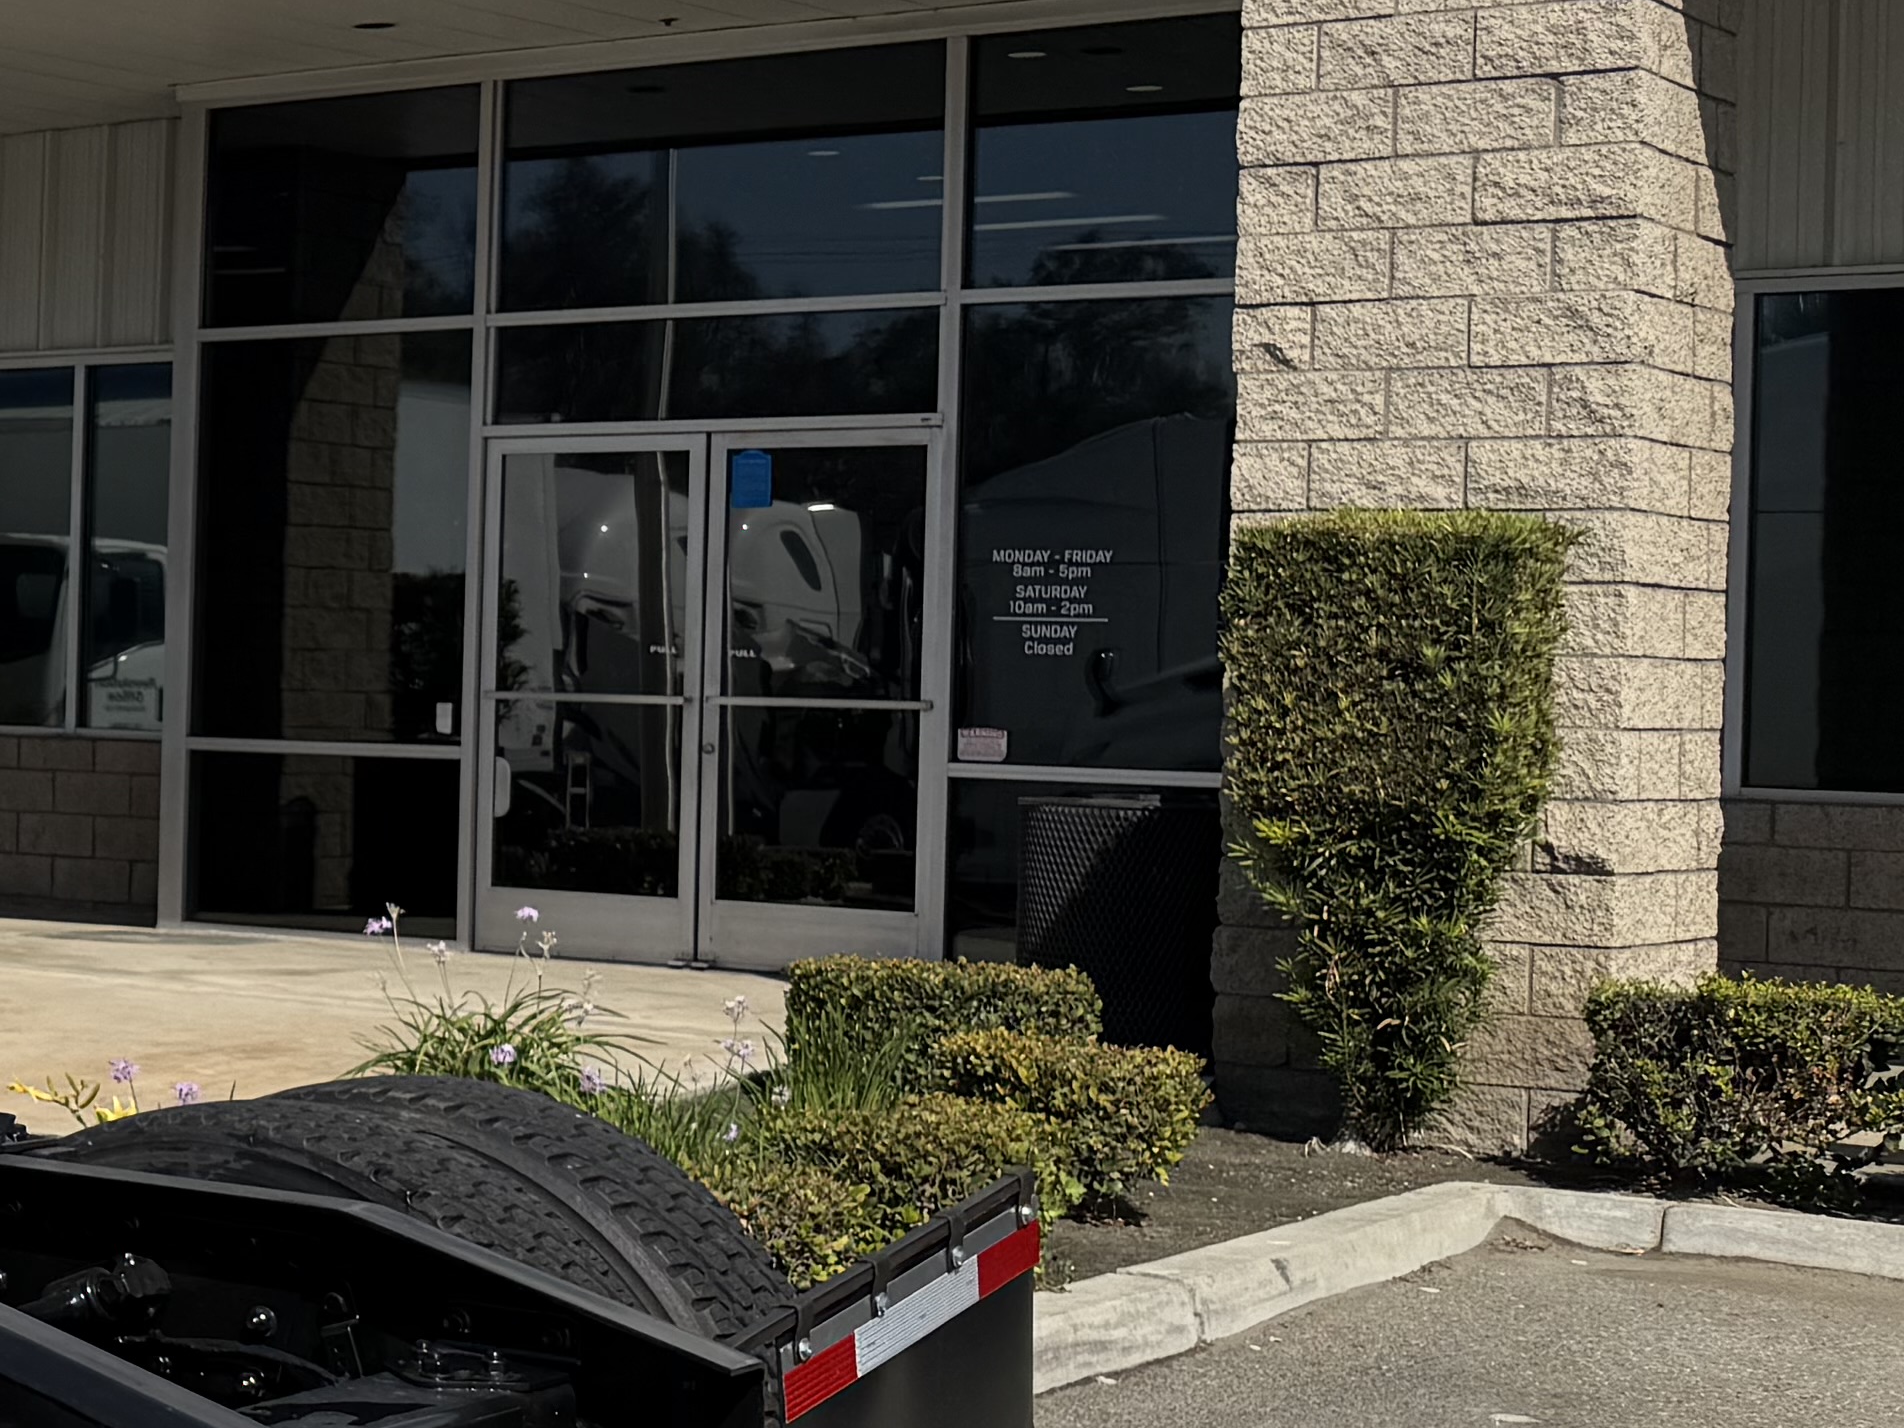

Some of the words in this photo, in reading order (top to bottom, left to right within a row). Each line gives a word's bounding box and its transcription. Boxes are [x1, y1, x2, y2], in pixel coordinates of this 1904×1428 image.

[992, 549, 1051, 563] MONDAY
[1064, 549, 1113, 563] FRIDAY
[1012, 563, 1045, 577] 8am
[1059, 563, 1092, 580] 5pm
[1015, 584, 1087, 599] SATURDAY
[1009, 600, 1047, 614] 10am
[1060, 600, 1093, 617] 2pm
[1021, 624, 1078, 639] SUNDAY
[1024, 640, 1074, 656] Closed
